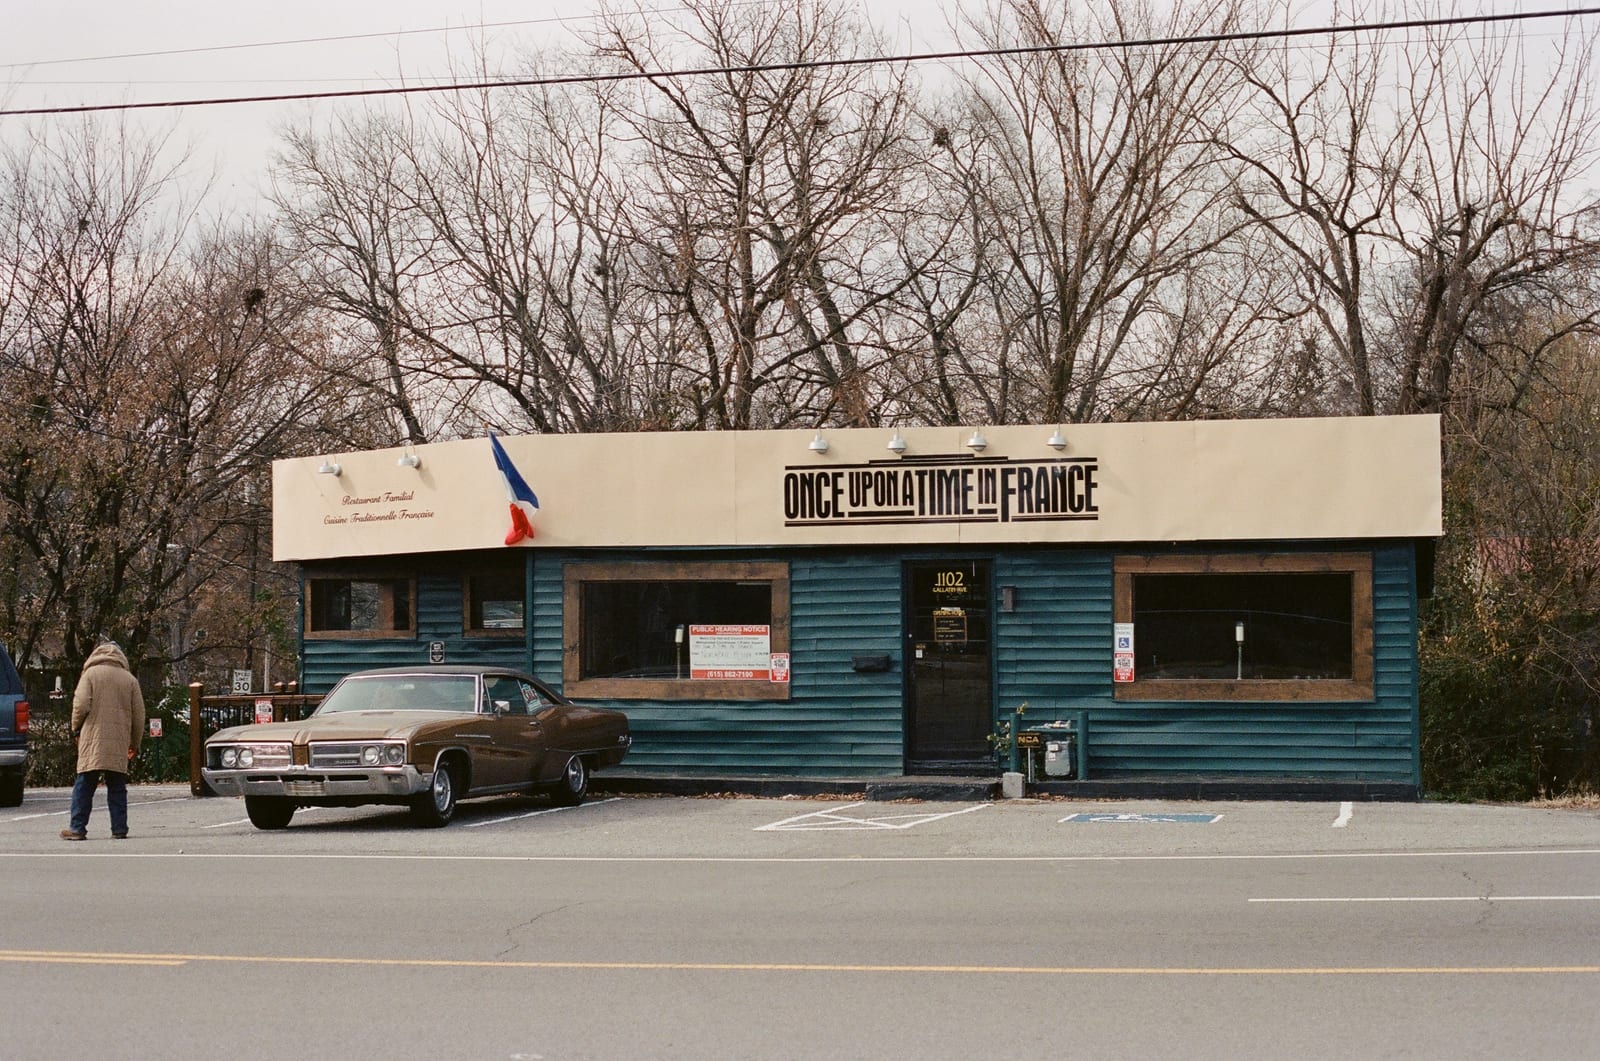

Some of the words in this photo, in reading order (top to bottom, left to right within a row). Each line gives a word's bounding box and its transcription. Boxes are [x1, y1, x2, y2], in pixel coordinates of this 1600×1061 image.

[341, 495, 381, 506] Restaurant
[383, 491, 414, 502] Familial
[784, 472, 845, 519] ONCE
[849, 470, 898, 507] UPON
[902, 470, 914, 506] A
[915, 468, 974, 516] TIME
[978, 468, 997, 504] IN
[1001, 465, 1098, 522] FRANCE
[323, 514, 348, 525] Cuisine
[350, 510, 398, 523] Traditionnelle
[399, 509, 434, 520] Française
[936, 572, 963, 586] 1102
[235, 682, 250, 691] 30
